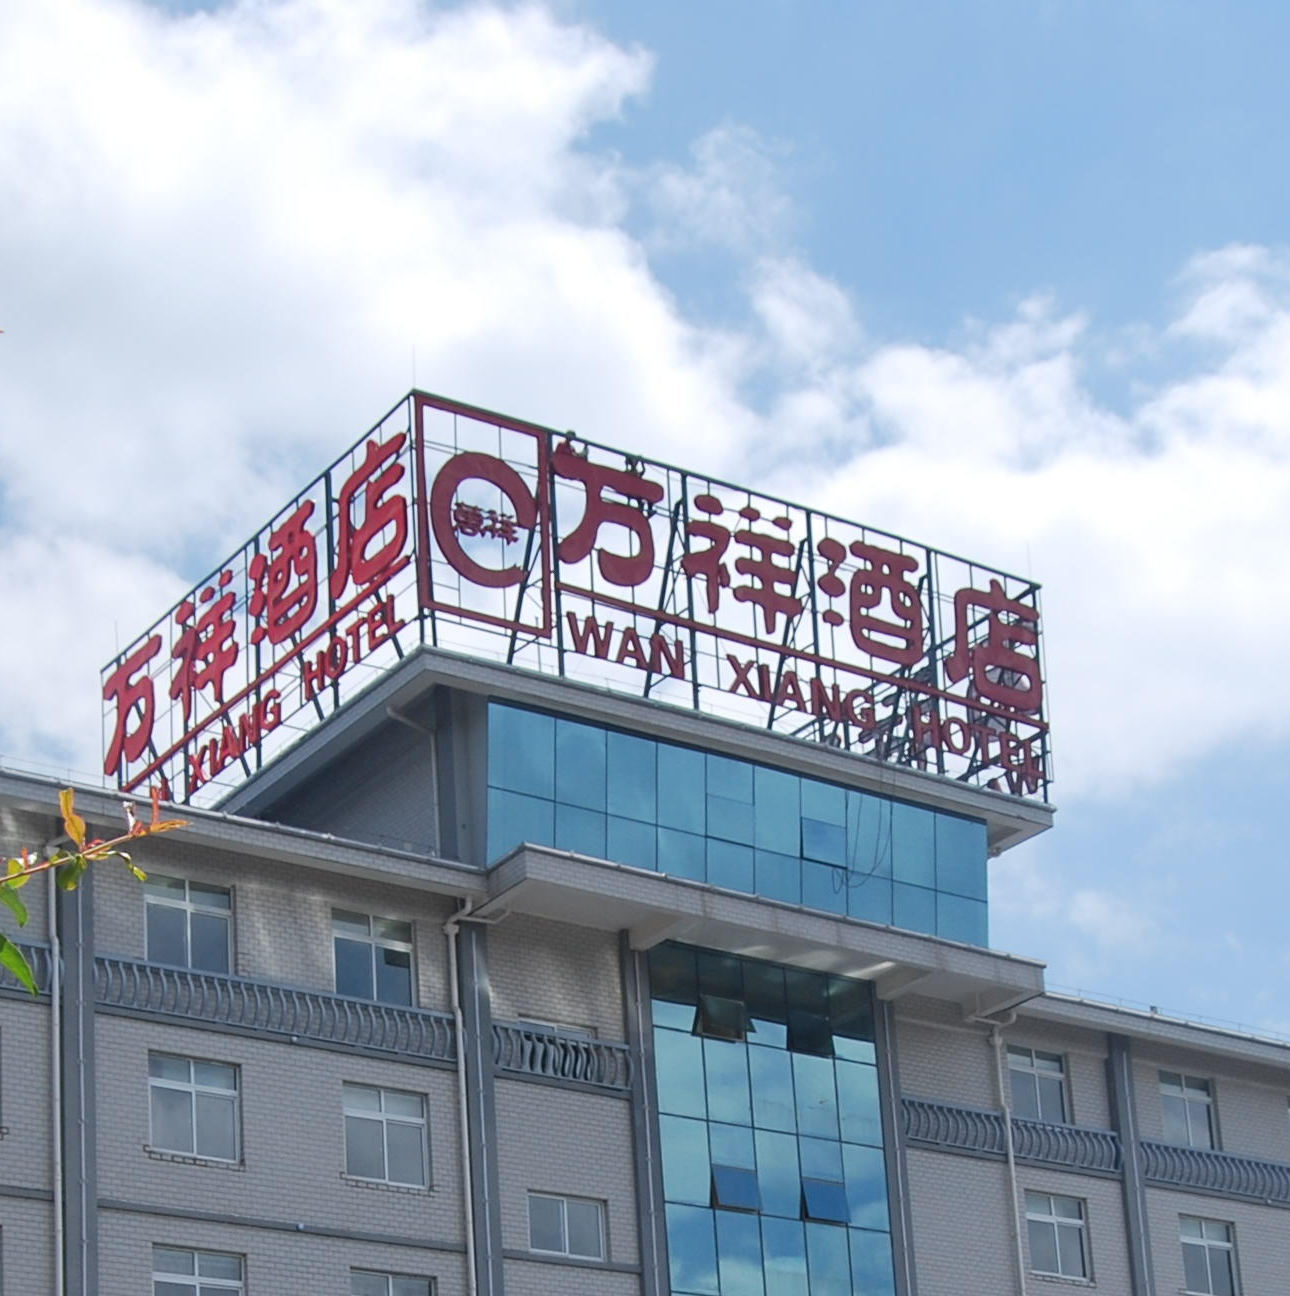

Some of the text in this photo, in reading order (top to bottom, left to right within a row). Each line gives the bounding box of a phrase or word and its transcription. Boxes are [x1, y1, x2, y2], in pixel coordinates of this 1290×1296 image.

[103, 432, 407, 776] 万祥酒店
[552, 441, 1041, 711] 万祥酒店
[188, 594, 406, 795] XIANG HOTEL
[566, 611, 1046, 780] WAN XIANG HOTEL
